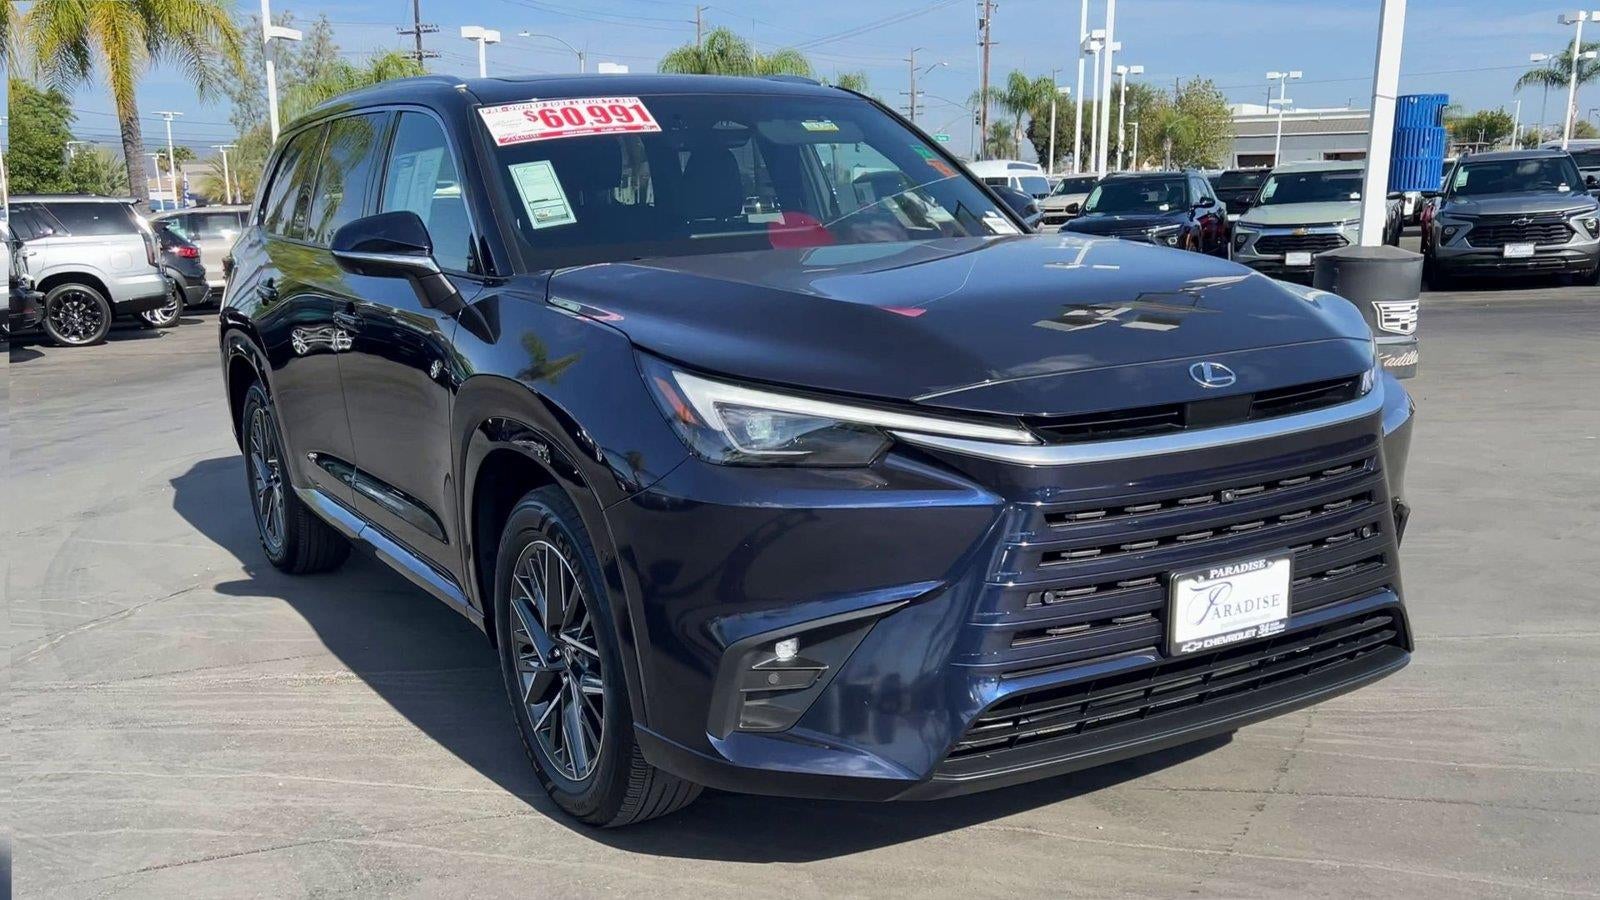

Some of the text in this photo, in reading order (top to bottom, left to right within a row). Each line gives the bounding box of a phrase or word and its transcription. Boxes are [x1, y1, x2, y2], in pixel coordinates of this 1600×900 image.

[523, 104, 651, 129] $60,991
[1209, 560, 1267, 579] PARADISE
[1187, 582, 1280, 625] PARADISE
[1203, 629, 1258, 648] CHEVROLET
